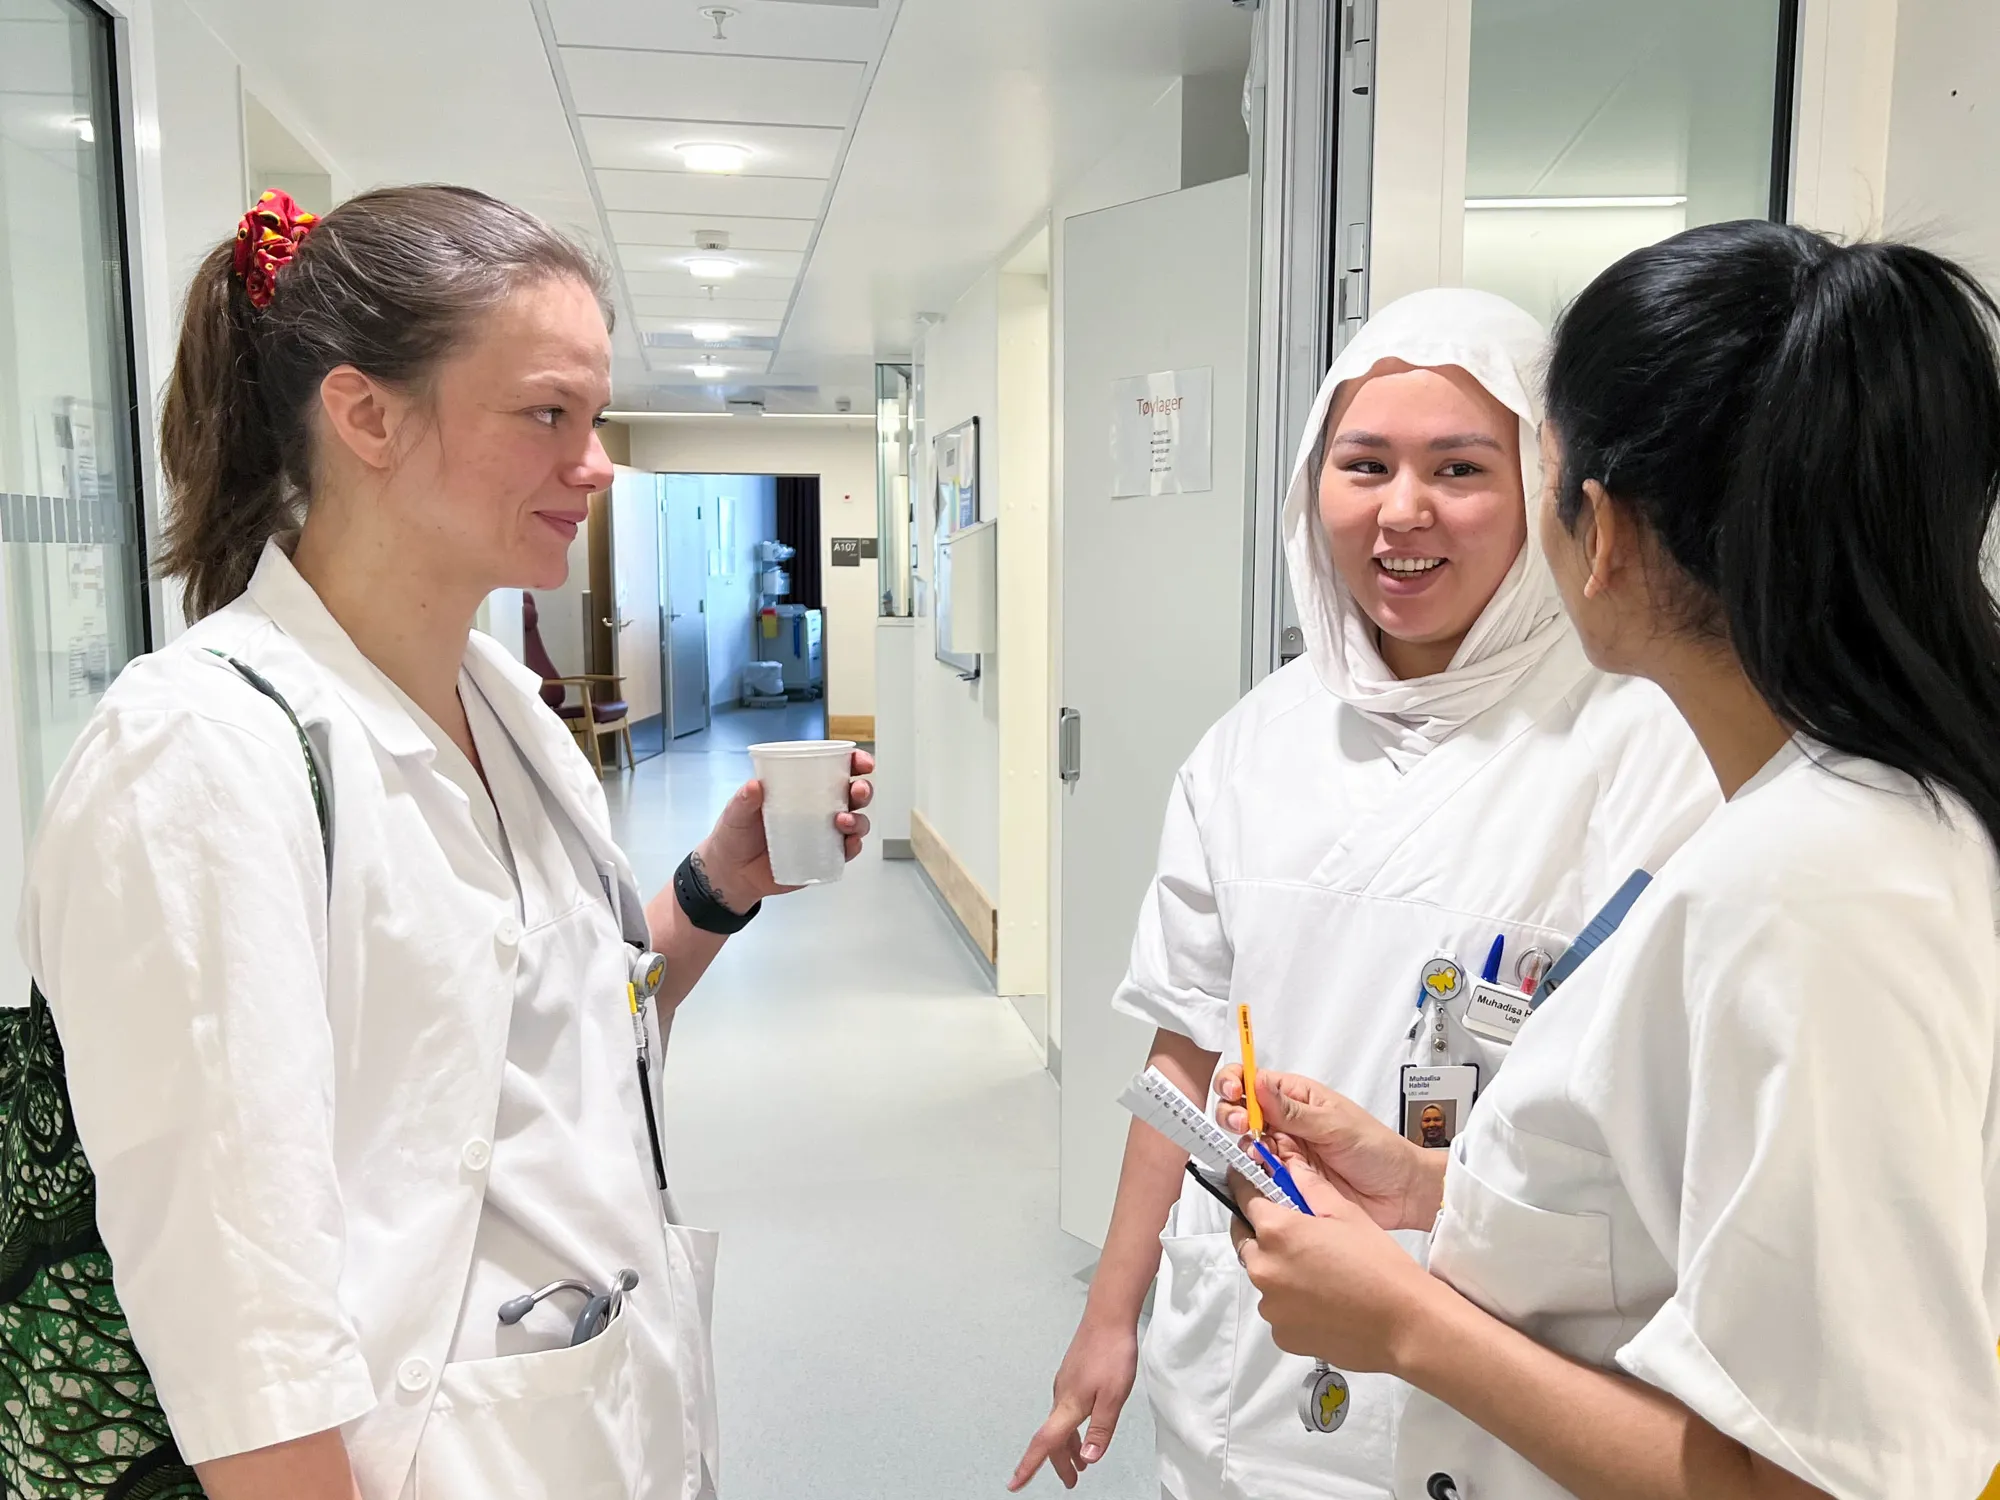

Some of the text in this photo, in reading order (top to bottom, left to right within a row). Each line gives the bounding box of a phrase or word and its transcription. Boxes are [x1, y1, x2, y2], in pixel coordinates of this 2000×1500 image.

[1136, 395, 1183, 418] Tøylager
[833, 543, 857, 551] A107
[1477, 995, 1522, 1015] Muhadisa
[1505, 1014, 1521, 1024] Lege
